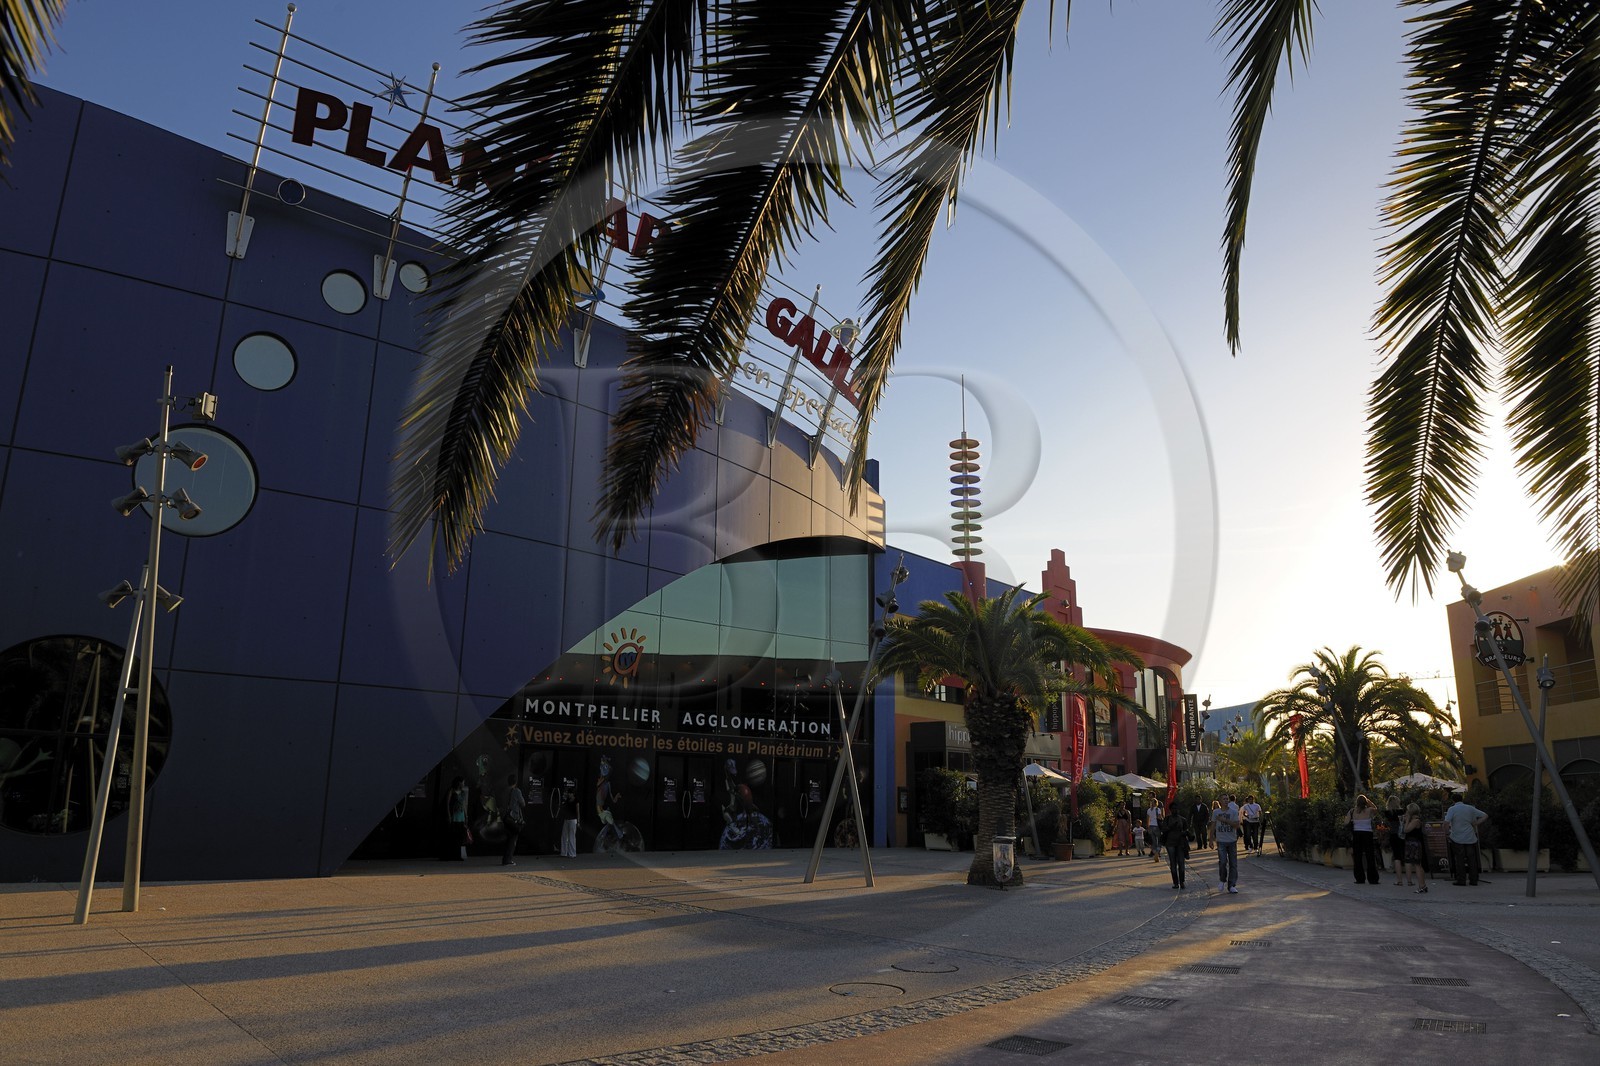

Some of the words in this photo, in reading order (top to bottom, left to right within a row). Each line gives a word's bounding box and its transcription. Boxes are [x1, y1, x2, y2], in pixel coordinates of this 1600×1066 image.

[742, 361, 771, 389] en
[525, 697, 661, 723] MONTPELLIER
[682, 711, 832, 735] AGGLOMERATION
[522, 726, 572, 746] Venez
[575, 730, 648, 750] décrocher
[652, 734, 673, 751] les
[677, 736, 723, 754] étoiles
[727, 741, 743, 755] au
[747, 740, 823, 759] Planétarium
